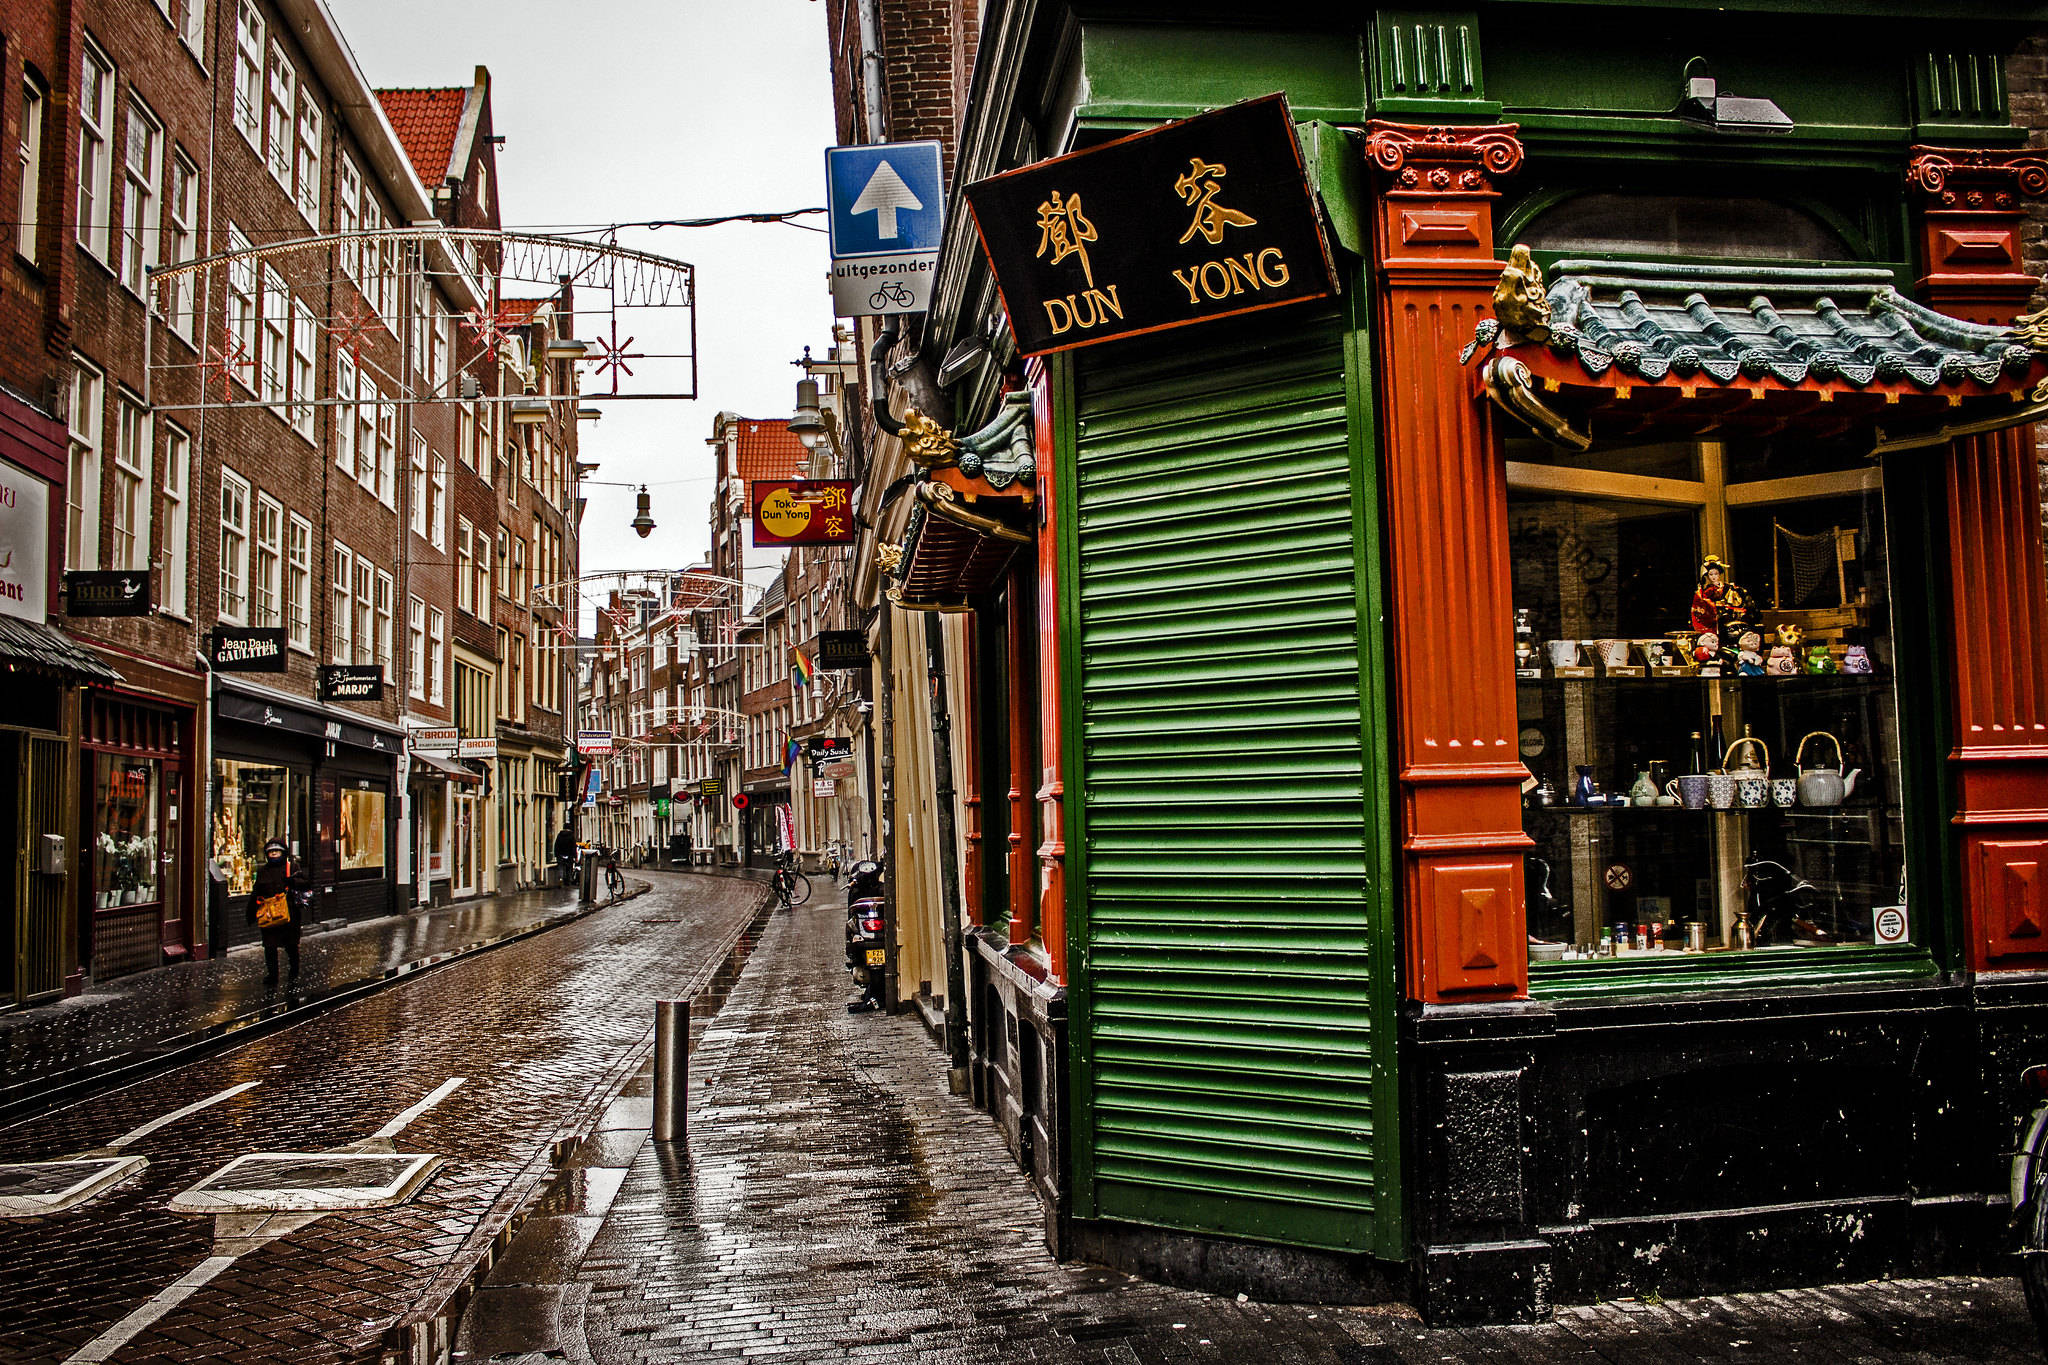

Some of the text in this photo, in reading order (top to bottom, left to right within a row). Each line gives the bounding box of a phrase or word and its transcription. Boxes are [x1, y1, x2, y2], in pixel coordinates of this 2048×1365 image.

[1042, 247, 1290, 335] DUN YONG
[774, 500, 798, 509] Toko
[762, 510, 809, 520] Dun Yong
[76, 585, 124, 600] BIRD
[221, 637, 274, 650] Jean Paul
[217, 644, 279, 663] GAULTIER
[826, 643, 866, 656] BIRD
[424, 730, 457, 739] BROOD
[466, 740, 496, 749] BROOD
[811, 749, 829, 757] Daily
